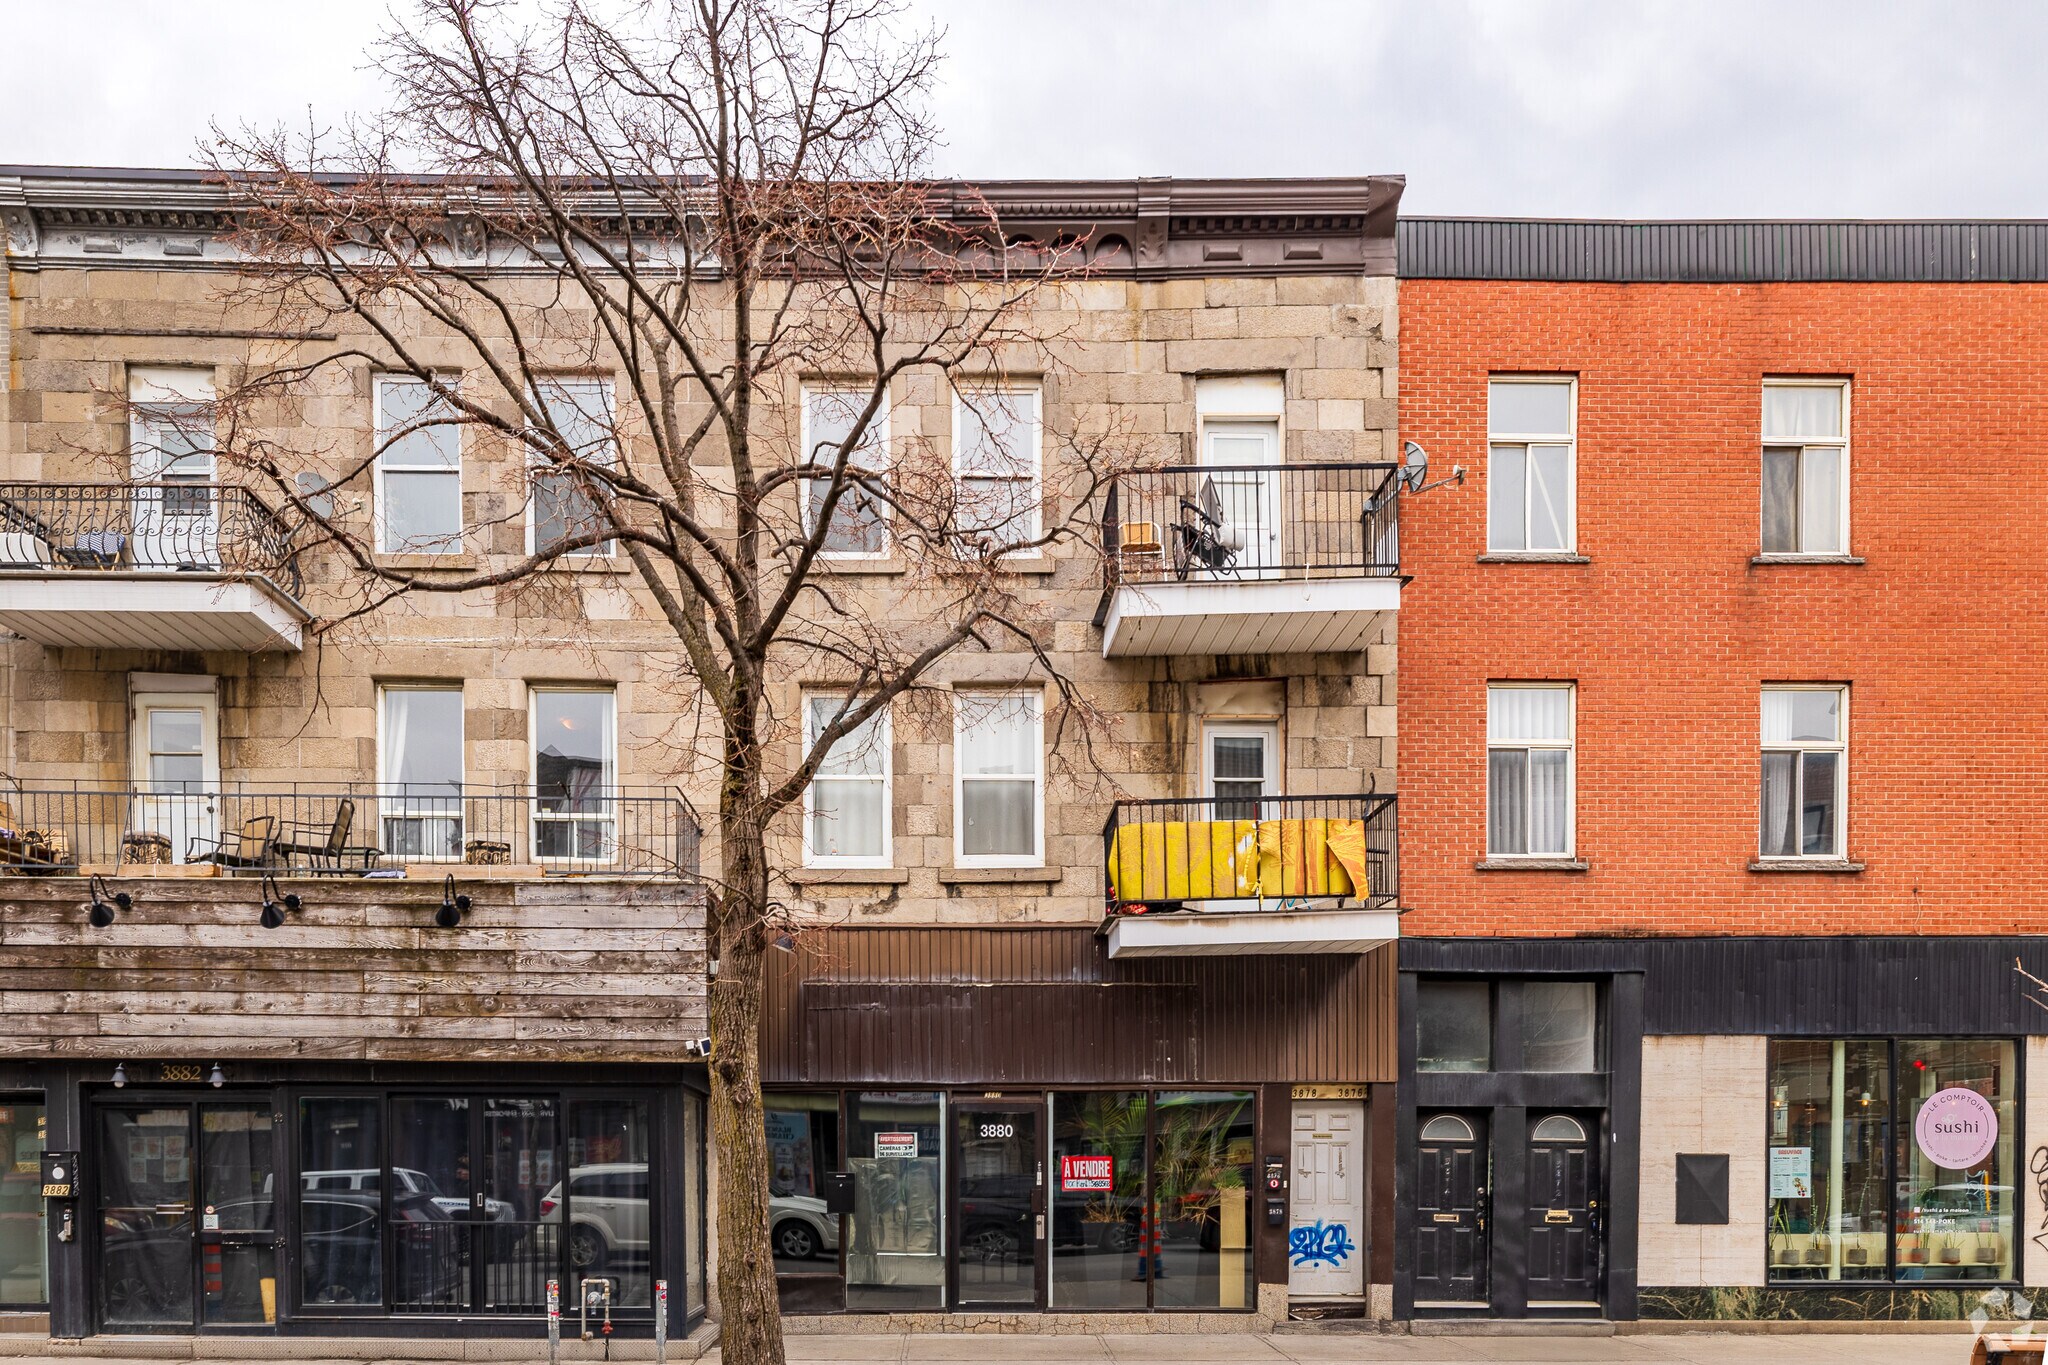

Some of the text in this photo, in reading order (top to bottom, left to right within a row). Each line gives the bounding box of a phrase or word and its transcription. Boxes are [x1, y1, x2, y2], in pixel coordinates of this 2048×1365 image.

[161, 1065, 201, 1081] 3882
[1292, 1088, 1317, 1098] 3878
[1928, 1094, 1984, 1112] LE COMPTOIR
[980, 1124, 1014, 1138] 3880
[1934, 1120, 1979, 1133] sushi
[1064, 1158, 1110, 1178] À VENDRE
[44, 1185, 69, 1196] 3882
